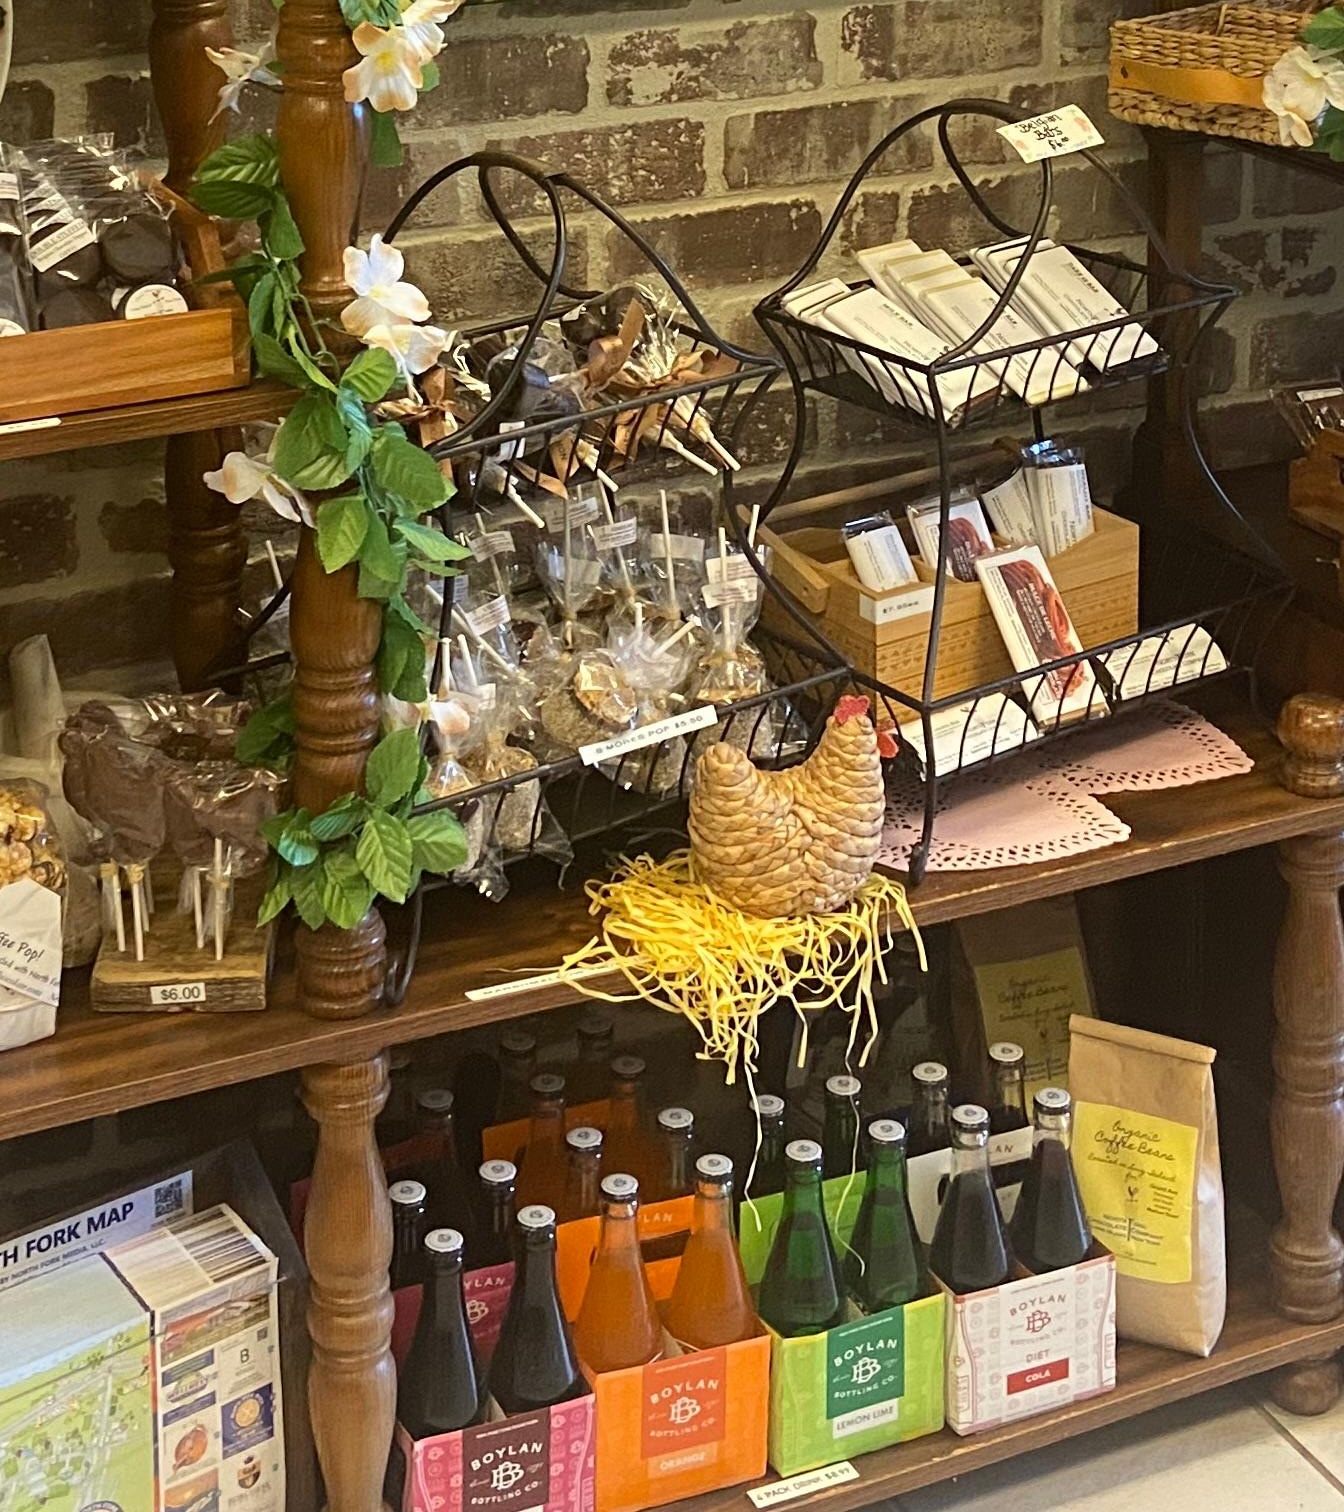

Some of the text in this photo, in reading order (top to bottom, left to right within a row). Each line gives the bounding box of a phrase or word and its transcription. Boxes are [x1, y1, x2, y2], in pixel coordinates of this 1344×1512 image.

[648, 725, 670, 737] POP
[17, 941, 45, 963] Pop!
[160, 985, 201, 1002] $6.00
[1112, 1120, 1160, 1143] Organic
[1094, 1130, 1176, 1161] Coffee Beans
[25, 1221, 82, 1258] FORK
[86, 1200, 135, 1240] MAP
[11, 1264, 39, 1281] NORTH
[40, 1256, 62, 1270] FORK
[1009, 1294, 1067, 1316] BOYLAN
[833, 1338, 898, 1368] BOYLAN
[1025, 1348, 1051, 1364] DIET
[1025, 1369, 1051, 1384] COLA
[650, 1378, 720, 1405] BOYLAN
[833, 1383, 880, 1400] BOTTLING
[836, 1405, 895, 1432] LEMON LIME
[649, 1425, 698, 1438] BOTTLING
[470, 1442, 544, 1472] BOYLAN
[659, 1452, 707, 1472] ORANGE
[470, 1488, 522, 1506] BOTTLING
[765, 1485, 792, 1500] PACK
[793, 1474, 823, 1492] DRINK
